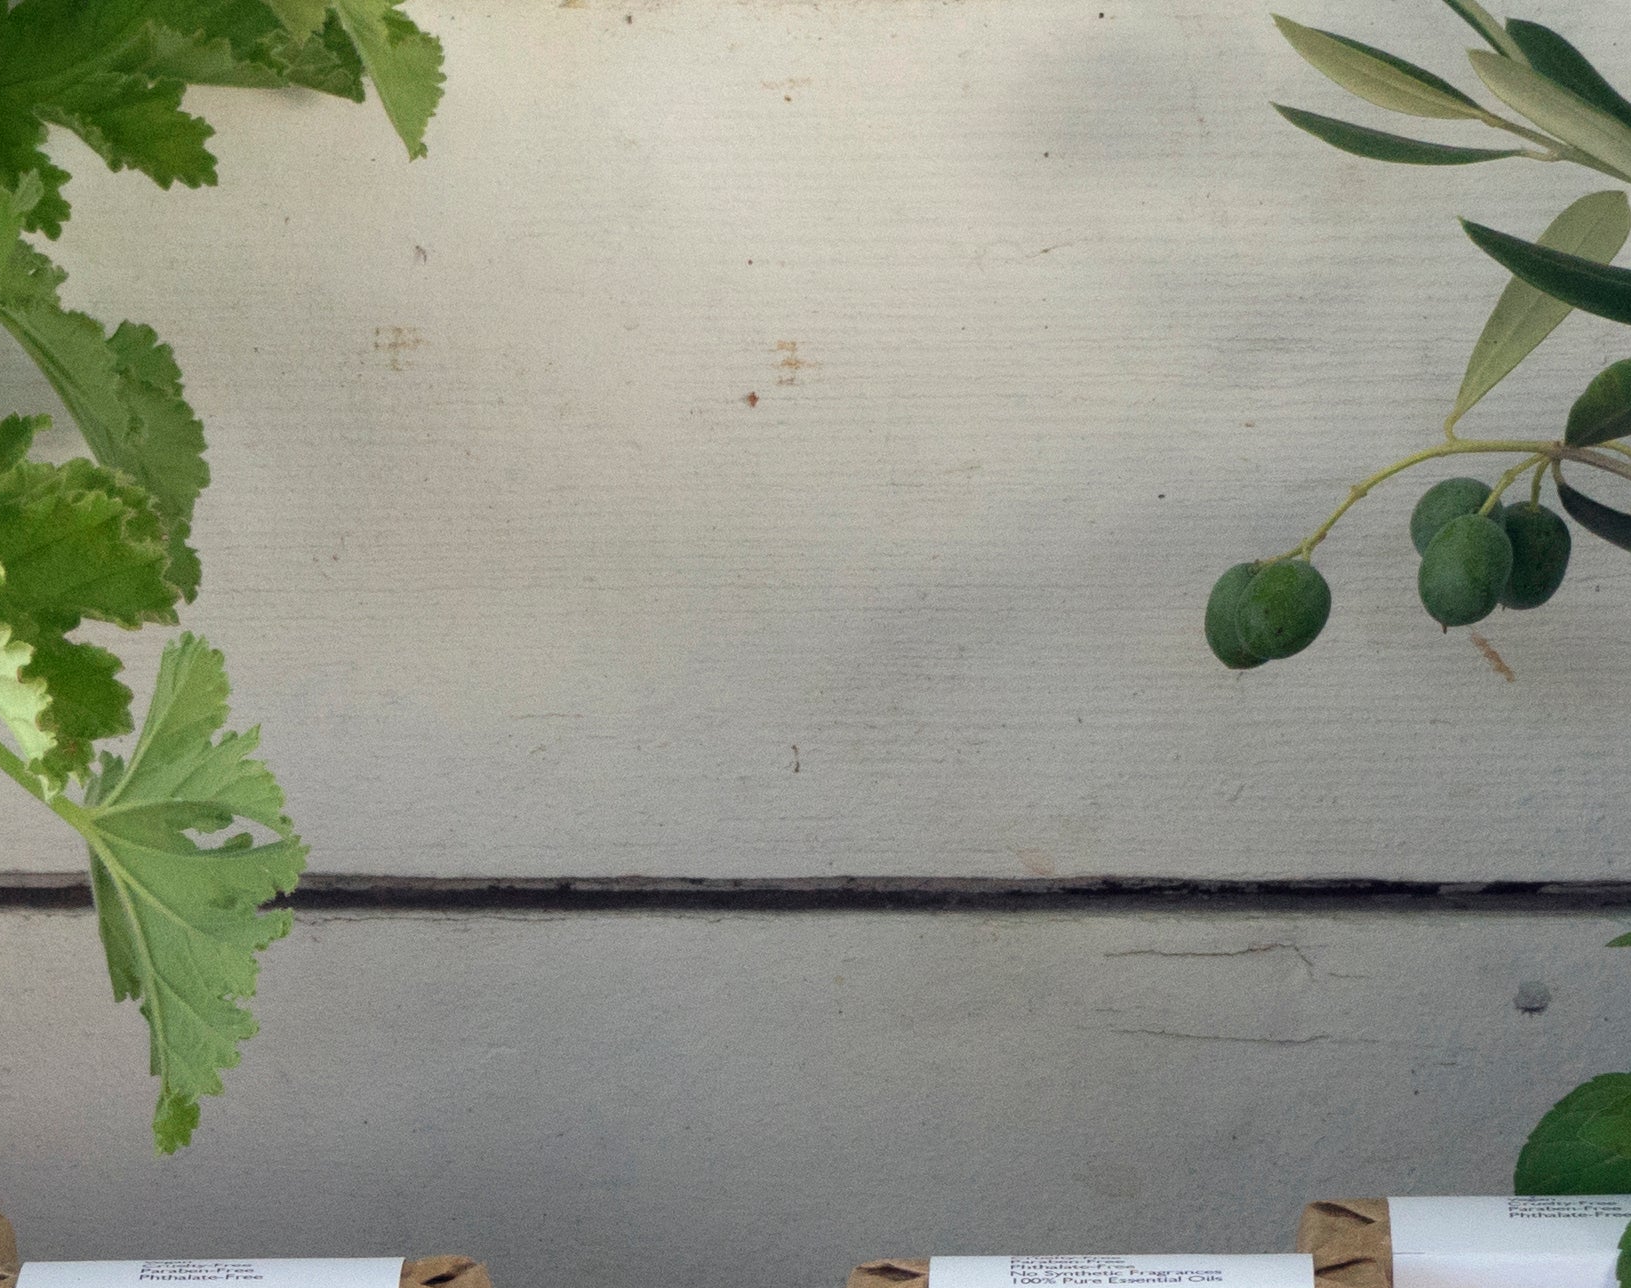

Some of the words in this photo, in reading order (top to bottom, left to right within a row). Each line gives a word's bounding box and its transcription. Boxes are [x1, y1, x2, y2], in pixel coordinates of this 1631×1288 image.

[1045, 1270, 1122, 1278] Synthetic
[1013, 1277, 1056, 1285] 100%
[1063, 1277, 1102, 1285] Pure
[1109, 1276, 1182, 1284] Essential
